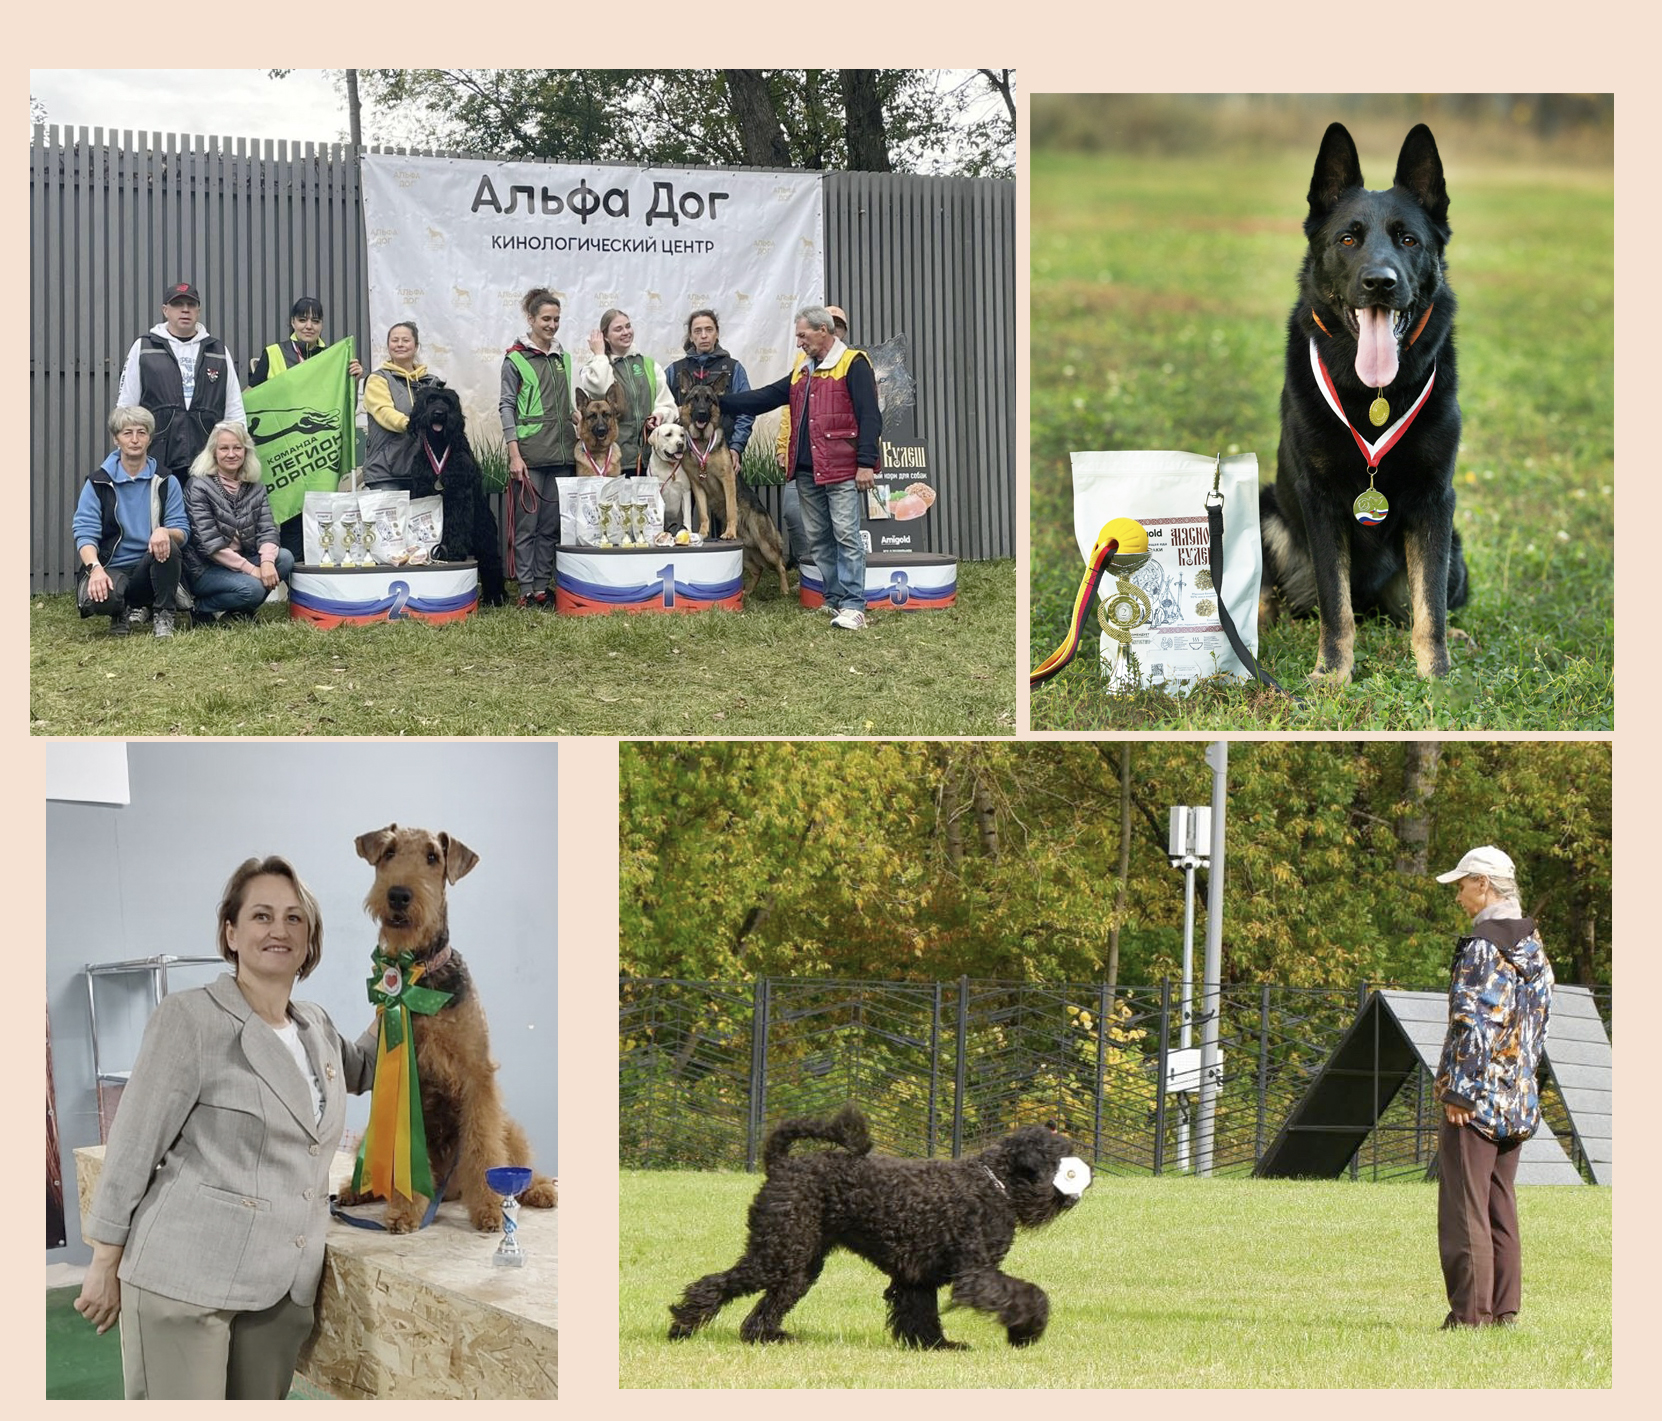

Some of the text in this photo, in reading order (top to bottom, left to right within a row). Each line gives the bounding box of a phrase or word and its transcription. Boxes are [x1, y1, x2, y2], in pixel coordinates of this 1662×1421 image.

[471, 174, 730, 227] Альфа Дог
[491, 235, 715, 256] КИНОЛОГИЧЕСКИЙ ЦЕНТР
[267, 436, 318, 465] КОМАНДА
[911, 471, 927, 479] собак
[881, 534, 911, 545] Amigold
[1171, 527, 1210, 546] МЯСНО
[656, 563, 674, 608] 1
[890, 570, 909, 606] 3
[388, 580, 410, 621] 2
